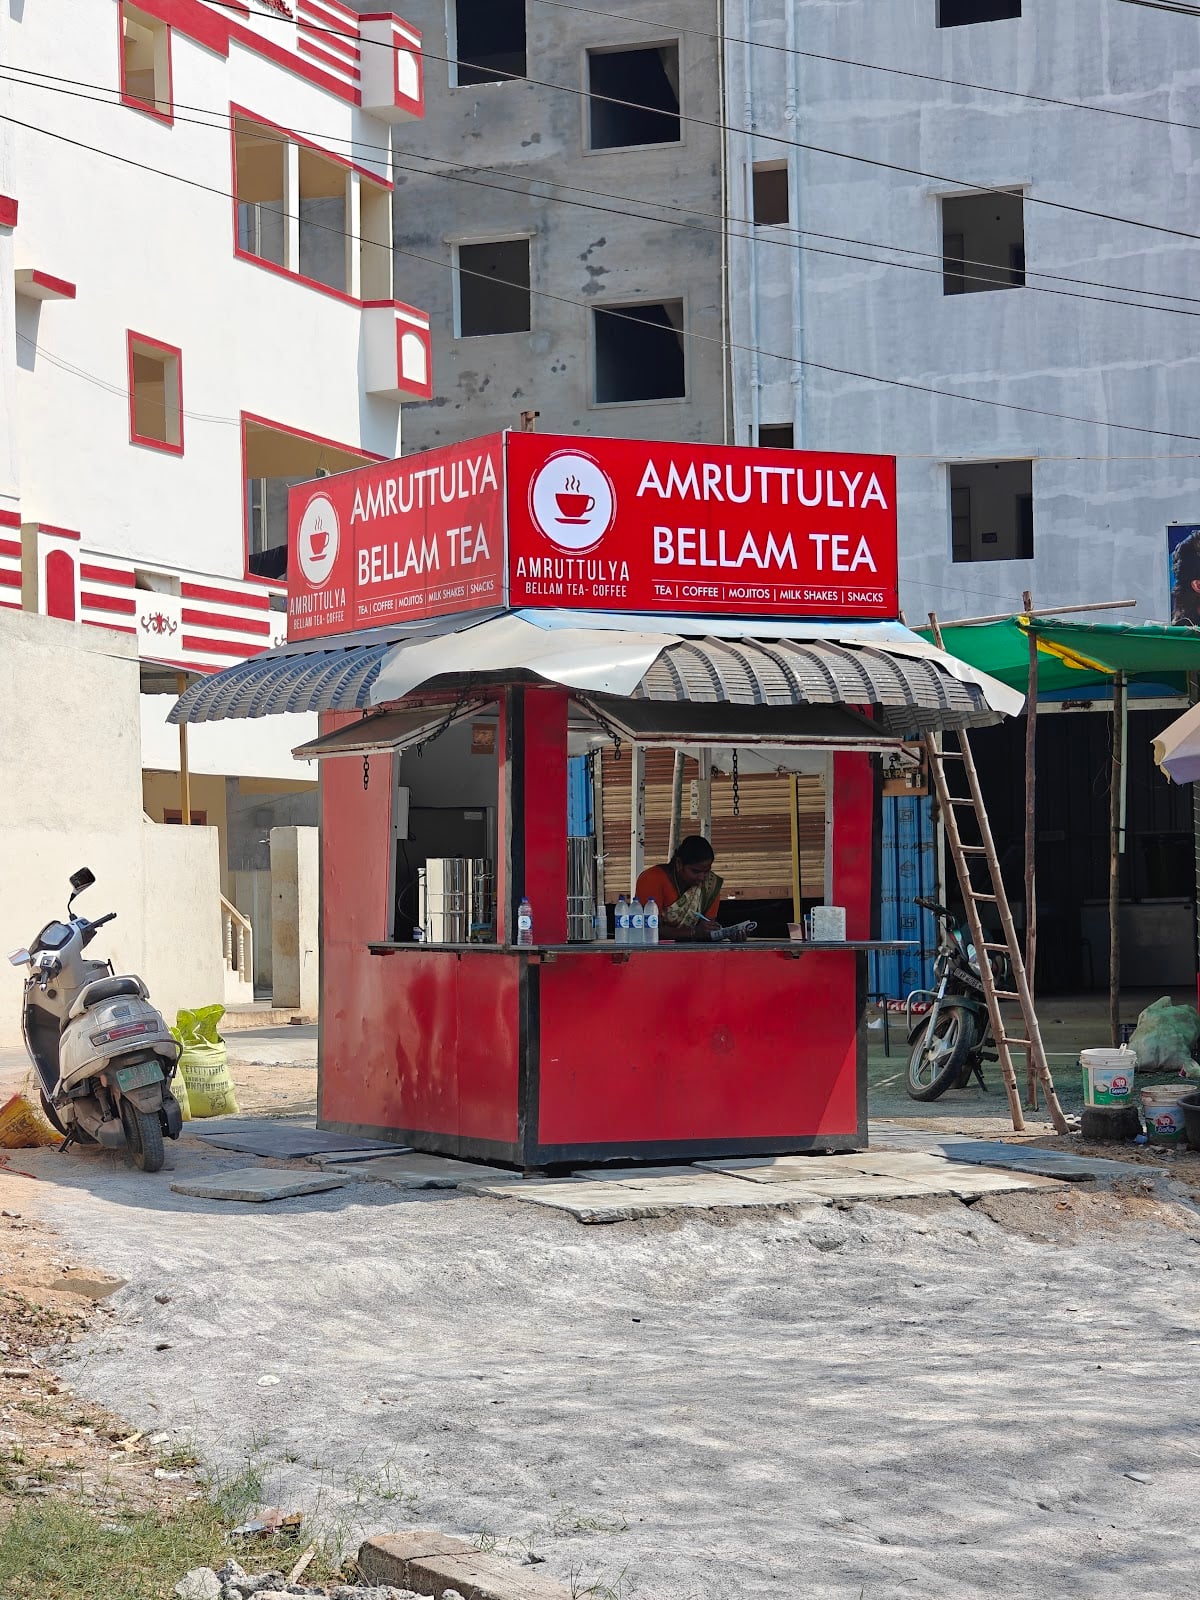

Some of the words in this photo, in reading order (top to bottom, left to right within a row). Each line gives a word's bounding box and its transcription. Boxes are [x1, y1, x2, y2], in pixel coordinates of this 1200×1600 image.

[350, 452, 498, 525] AMRUTTULYA
[636, 458, 889, 511] AMRUTTULYA
[358, 532, 440, 586] BELLAM
[446, 522, 490, 567] TEA
[653, 525, 798, 571] BELLAM
[808, 533, 878, 573] TEA
[516, 556, 630, 582] AMRUTTULYA
[290, 587, 346, 616] AMRUTTULYA
[358, 605, 368, 615] TEA
[372, 599, 394, 612] COFFEE
[398, 594, 424, 608] MOJITOS
[428, 590, 442, 602] MILK
[443, 586, 465, 599] SHAKES
[470, 580, 494, 594] SNACKS
[525, 581, 563, 595] BELLAM
[592, 584, 627, 598] COFFEE
[654, 584, 672, 595] TEA
[682, 585, 719, 598] COFFEE
[728, 587, 770, 599] MOJITOS
[779, 588, 802, 600] MILK
[803, 589, 838, 601] SHAKES
[847, 591, 884, 603] SNACKS
[293, 616, 313, 630] BELLAM
[326, 610, 344, 625] COFFEE
